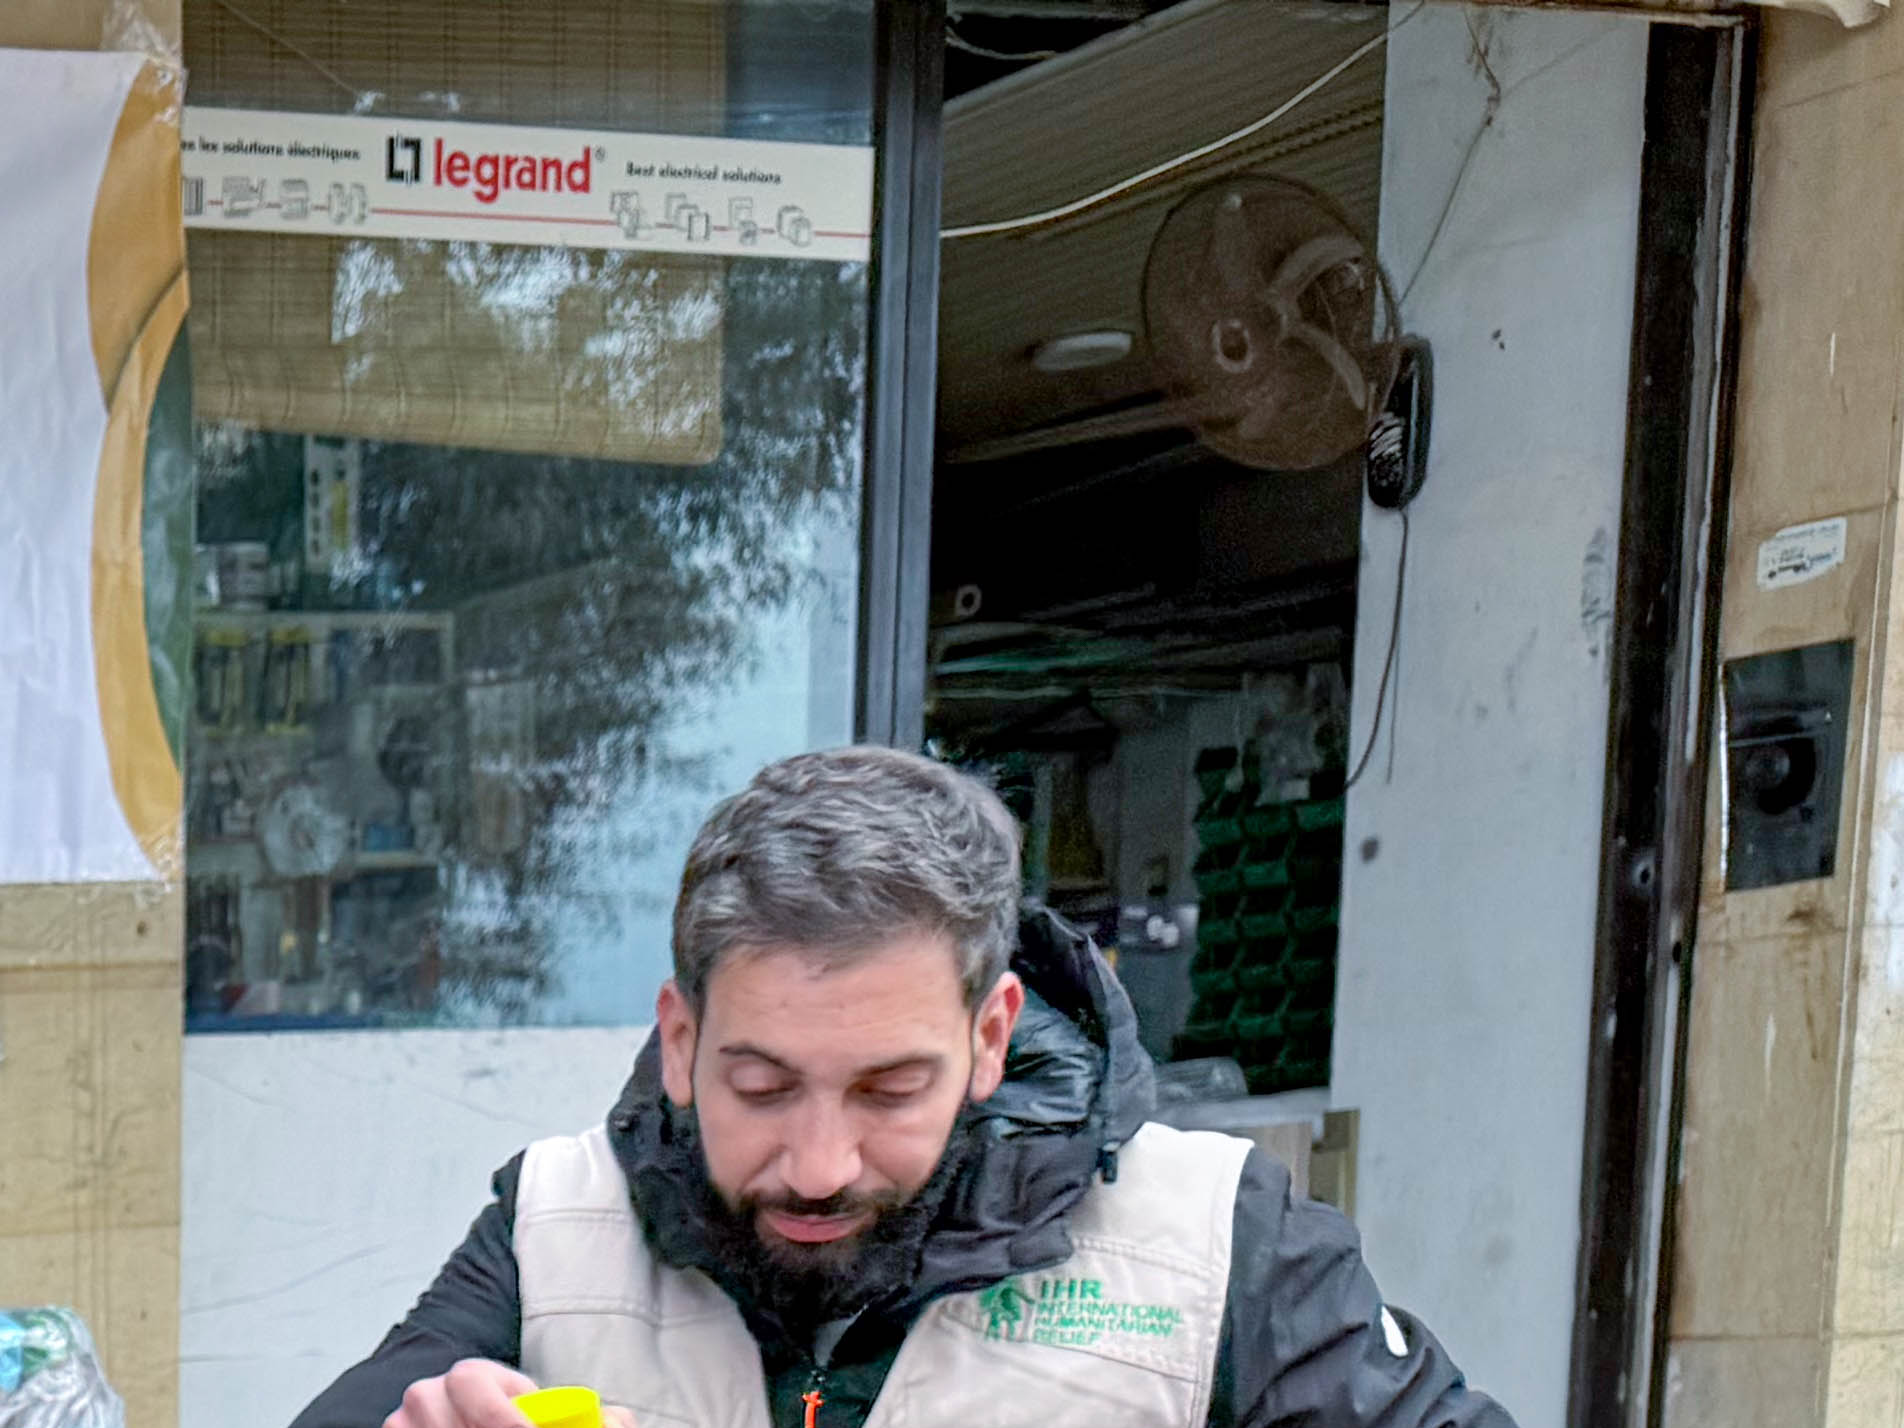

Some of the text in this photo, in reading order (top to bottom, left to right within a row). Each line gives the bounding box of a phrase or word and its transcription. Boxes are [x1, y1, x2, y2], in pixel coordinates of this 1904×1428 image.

[434, 138, 591, 204] legrand
[1039, 1278, 1103, 1299] IHR
[1035, 1301, 1185, 1324] INTERNATIONAL
[1032, 1327, 1102, 1346] RELIEF
[1034, 1317, 1174, 1338] HUMANITARIAN
